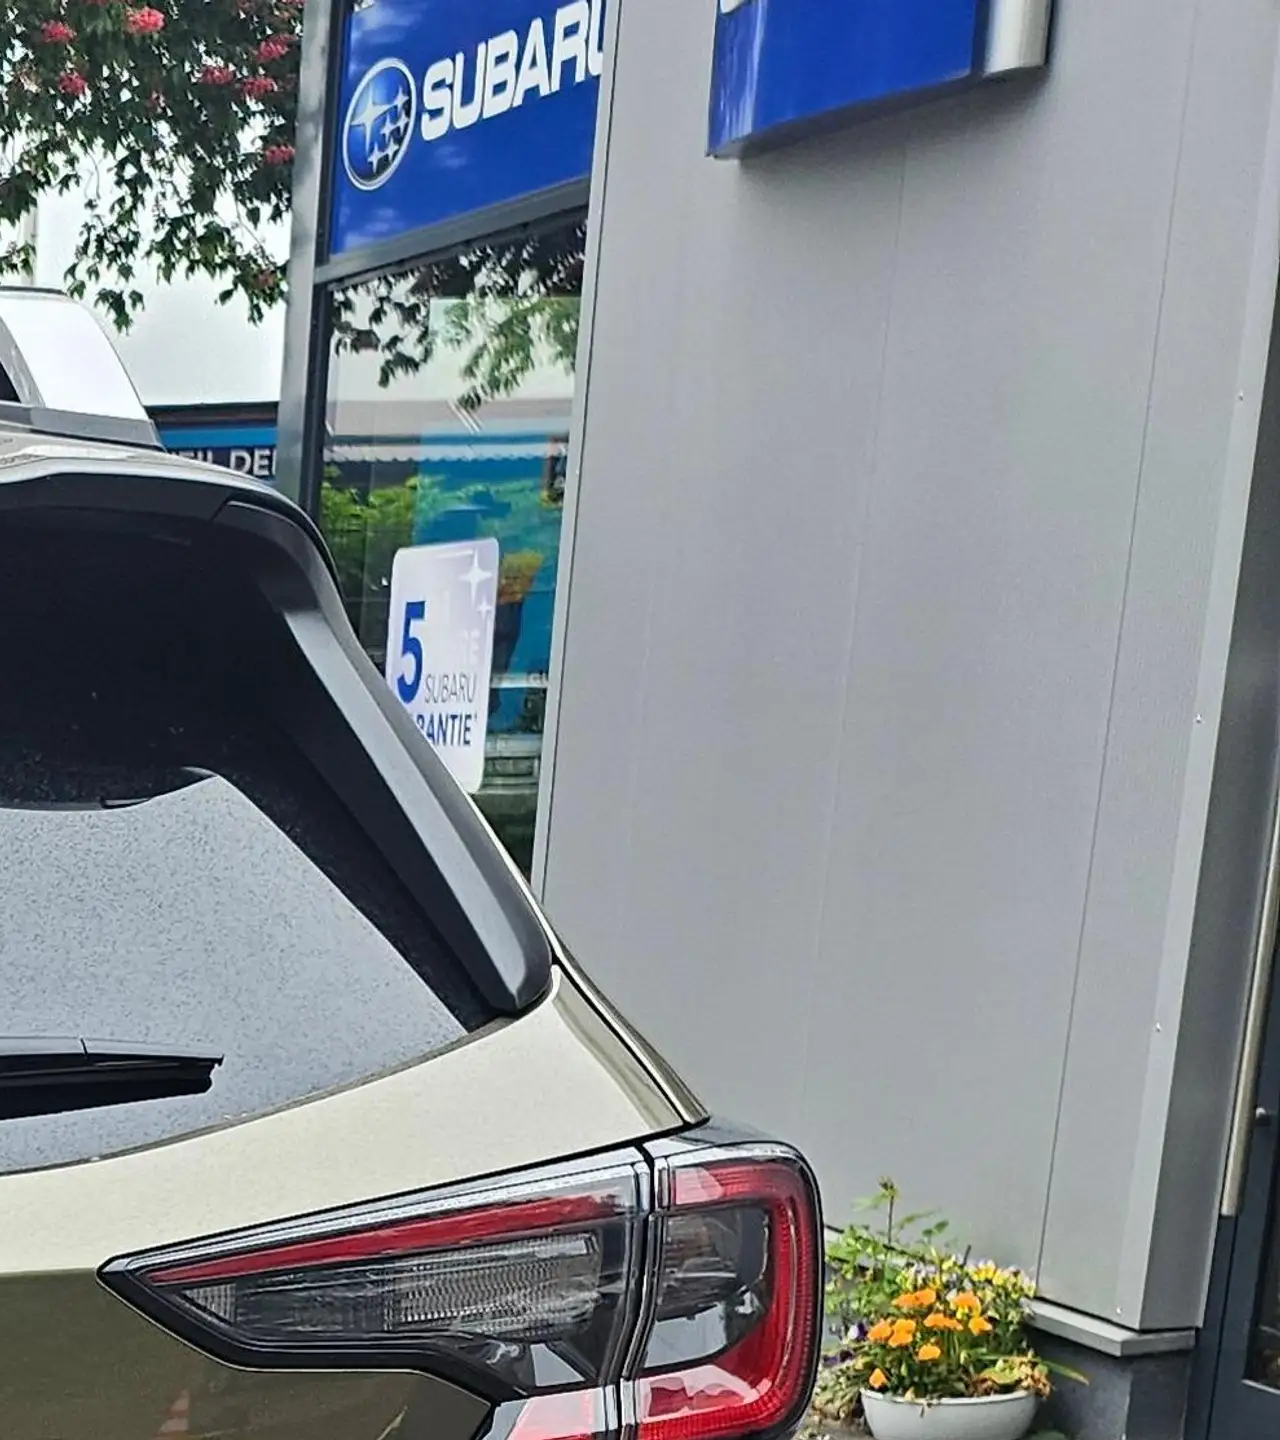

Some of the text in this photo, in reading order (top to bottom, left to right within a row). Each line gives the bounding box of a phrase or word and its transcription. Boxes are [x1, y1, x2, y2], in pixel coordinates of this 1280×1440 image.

[229, 448, 277, 476] DE
[397, 601, 426, 705] 5
[424, 672, 477, 704] SUBARU
